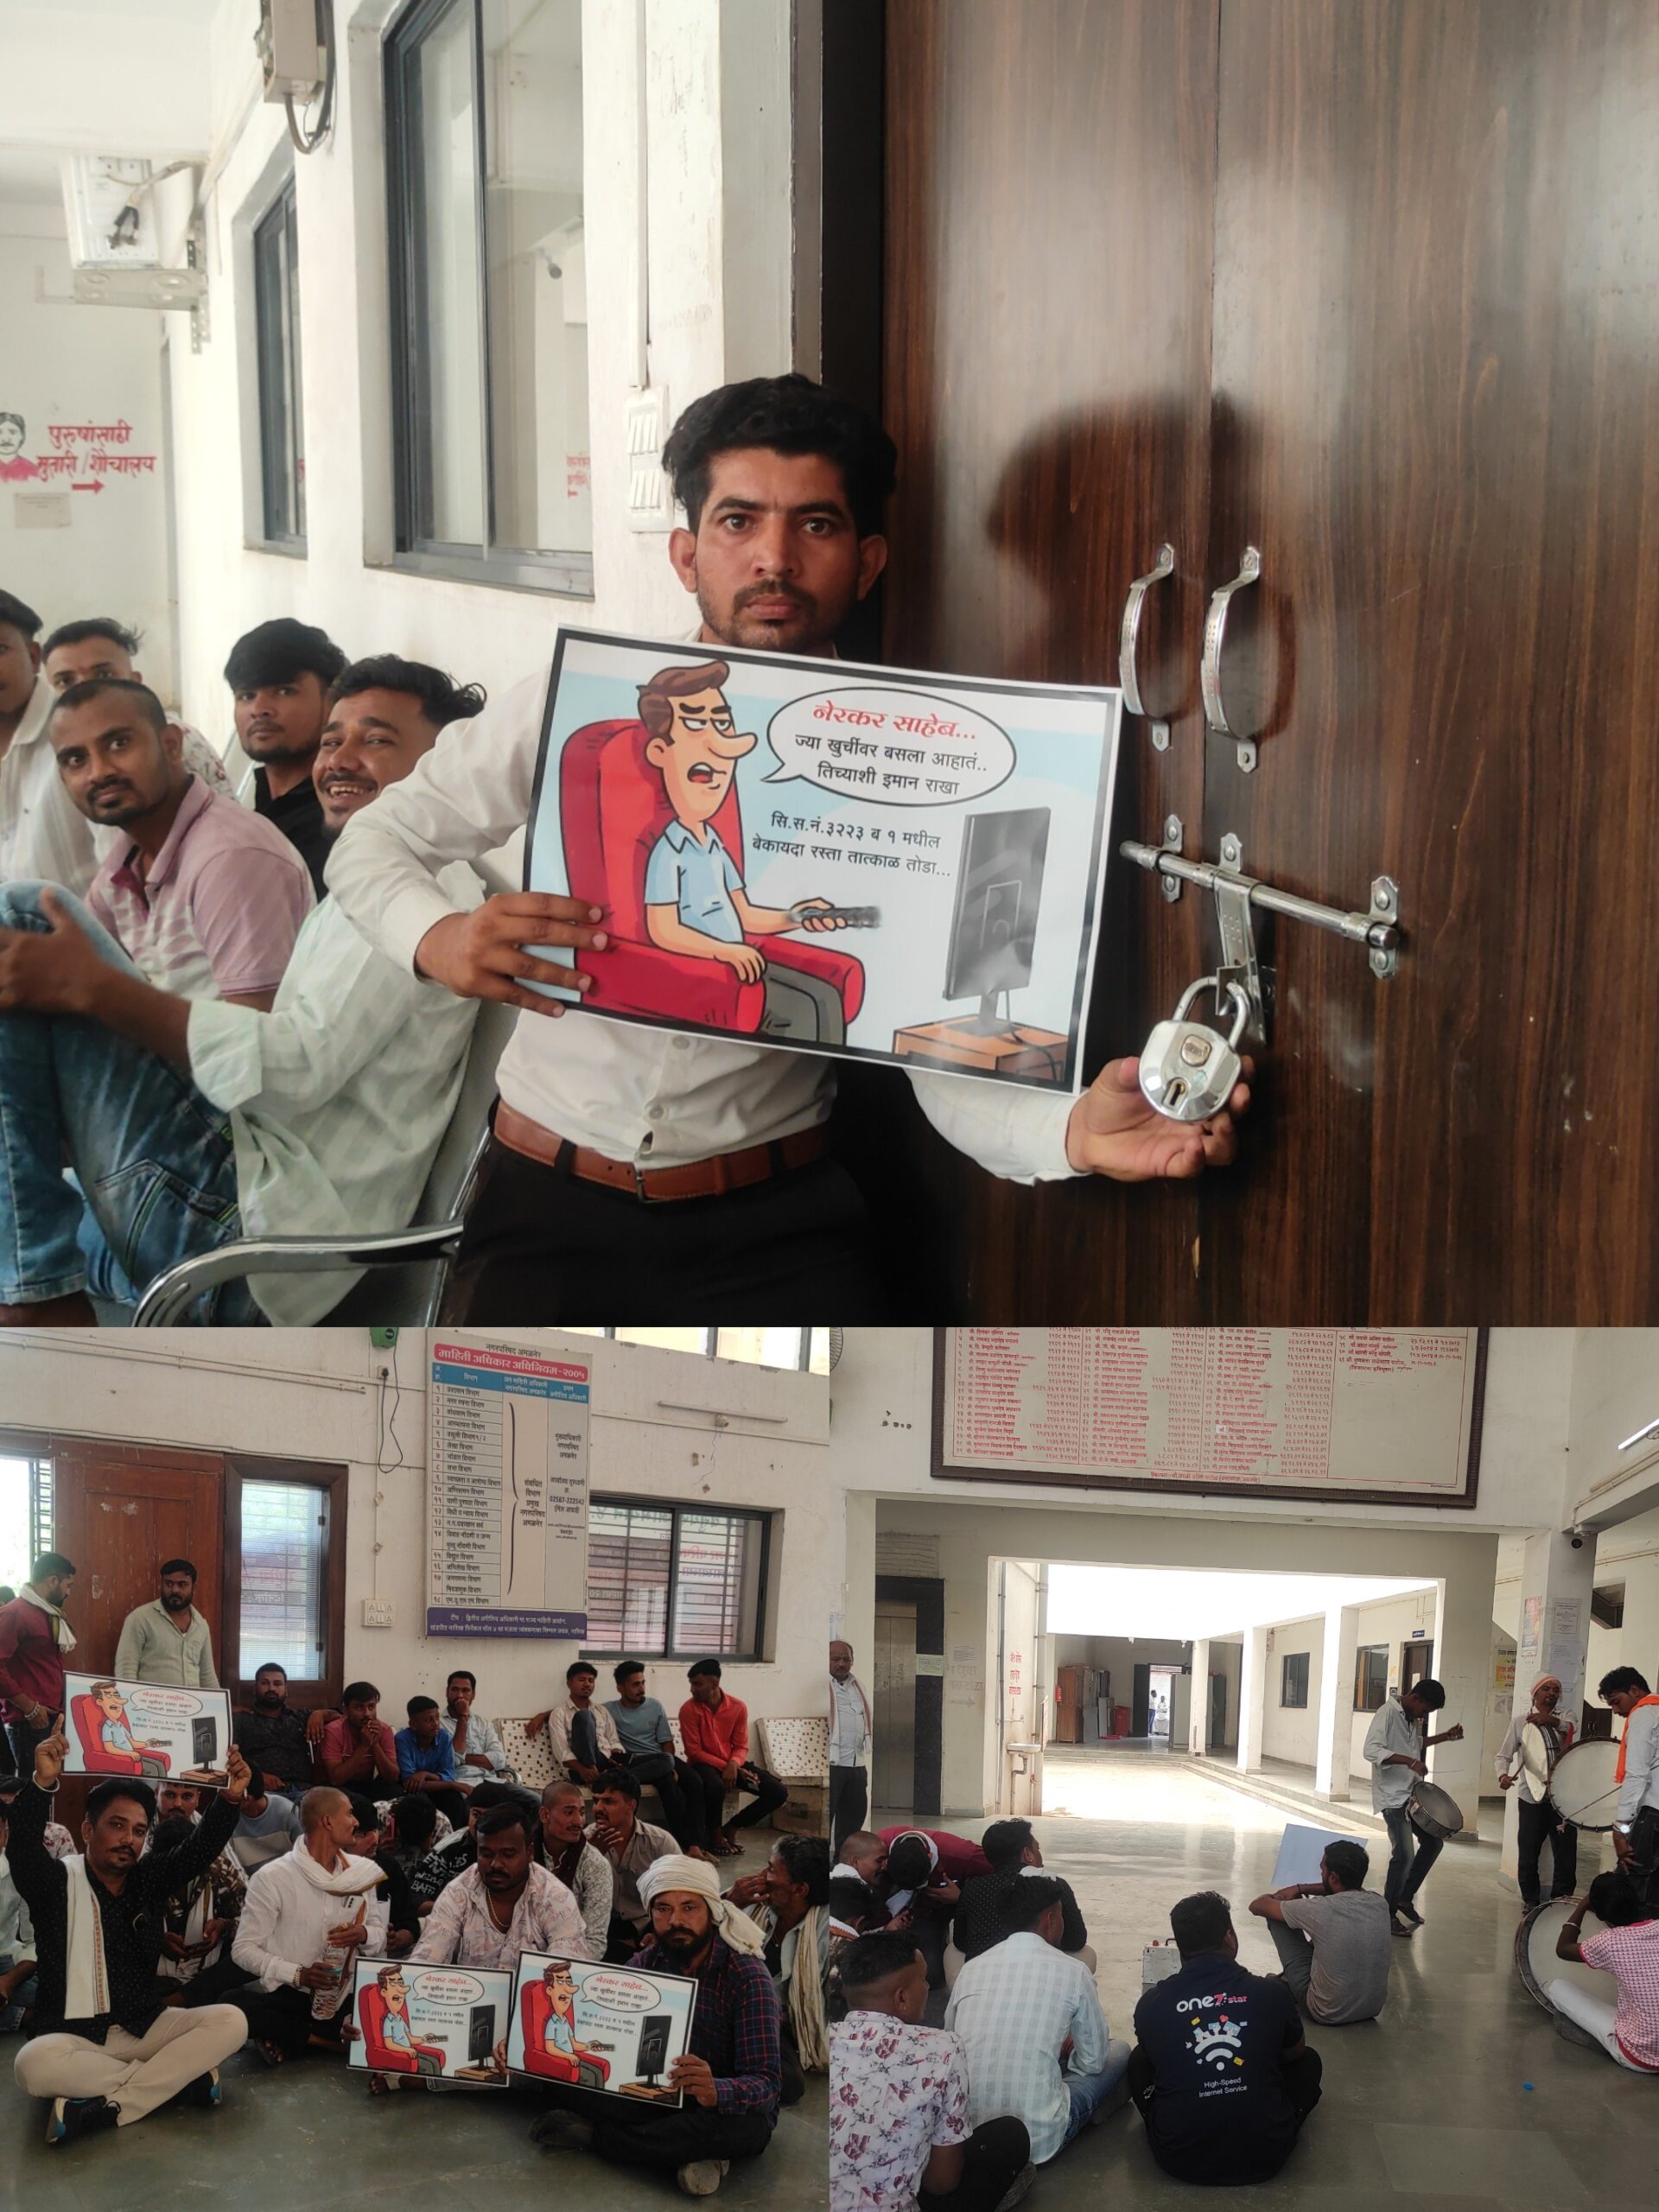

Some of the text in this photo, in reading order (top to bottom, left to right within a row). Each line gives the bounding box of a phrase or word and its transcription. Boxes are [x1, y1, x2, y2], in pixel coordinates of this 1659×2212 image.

[90, 448, 156, 478] शौचालय
[812, 700, 976, 740] नेरकर साहेब...
[795, 734, 821, 751] ज्या
[827, 735, 879, 759] खुर्चीवर
[884, 745, 925, 765] बसला
[817, 760, 958, 796] तिच्याशी इमान राखा
[753, 832, 805, 858] बेकायदा
[810, 845, 842, 862] रस्ता
[847, 850, 900, 870] तात्काळ
[870, 827, 881, 842] ब
[887, 830, 897, 844] १
[902, 831, 942, 850] मधील
[438, 1349, 471, 1363] माहिती
[473, 1354, 511, 1368] अधिकार
[1198, 2084, 1248, 2098] Internet Service
[1204, 2076, 1242, 2088] High-Speed
